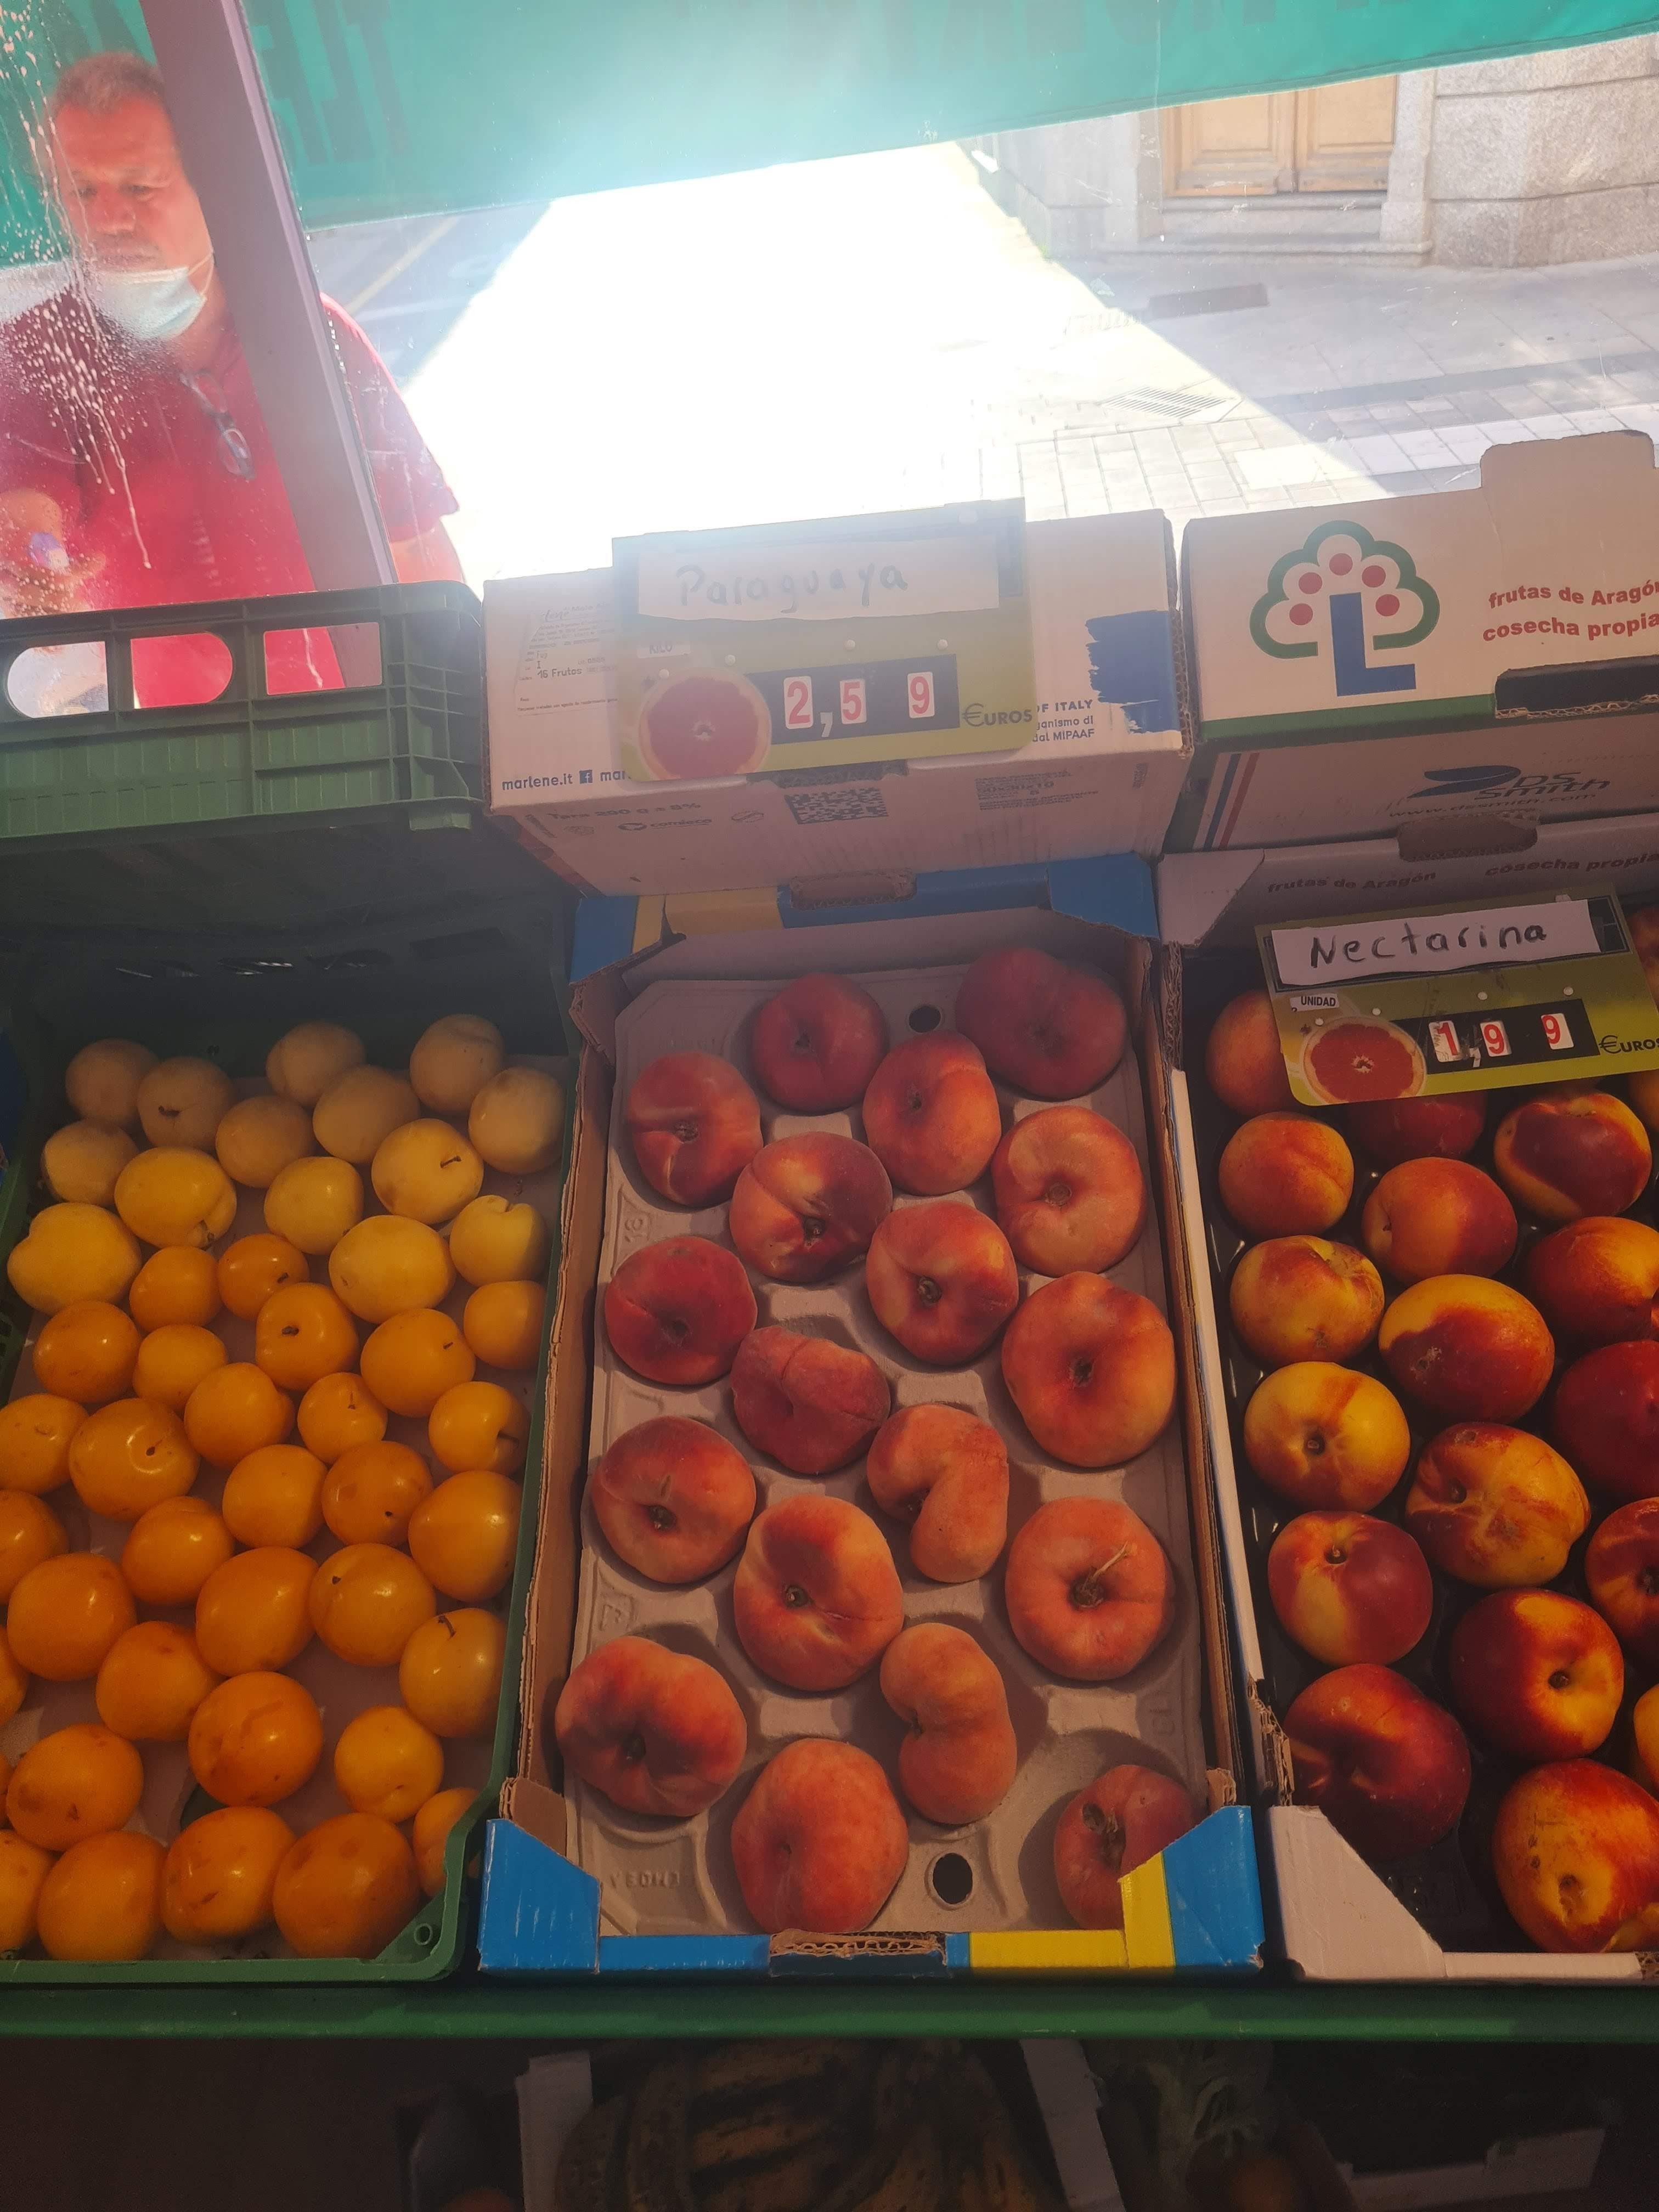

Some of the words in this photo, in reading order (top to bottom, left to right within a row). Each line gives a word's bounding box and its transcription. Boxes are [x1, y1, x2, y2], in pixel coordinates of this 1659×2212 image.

[1488, 585, 1551, 609] frutas
[1558, 586, 1584, 604] de
[1482, 617, 1580, 642] cosecha
[1055, 699, 1093, 712] ITALY
[1083, 715, 1094, 725] di
[1053, 729, 1095, 741] MIPAAF
[501, 773, 573, 791] marlene.it
[1484, 859, 1580, 876] cosecha
[1267, 878, 1327, 893] frutas
[1334, 878, 1357, 889] de
[1362, 870, 1436, 889] Aragón
[1310, 922, 1547, 968] Nectarina
[1301, 996, 1336, 1007] UNIDAD
